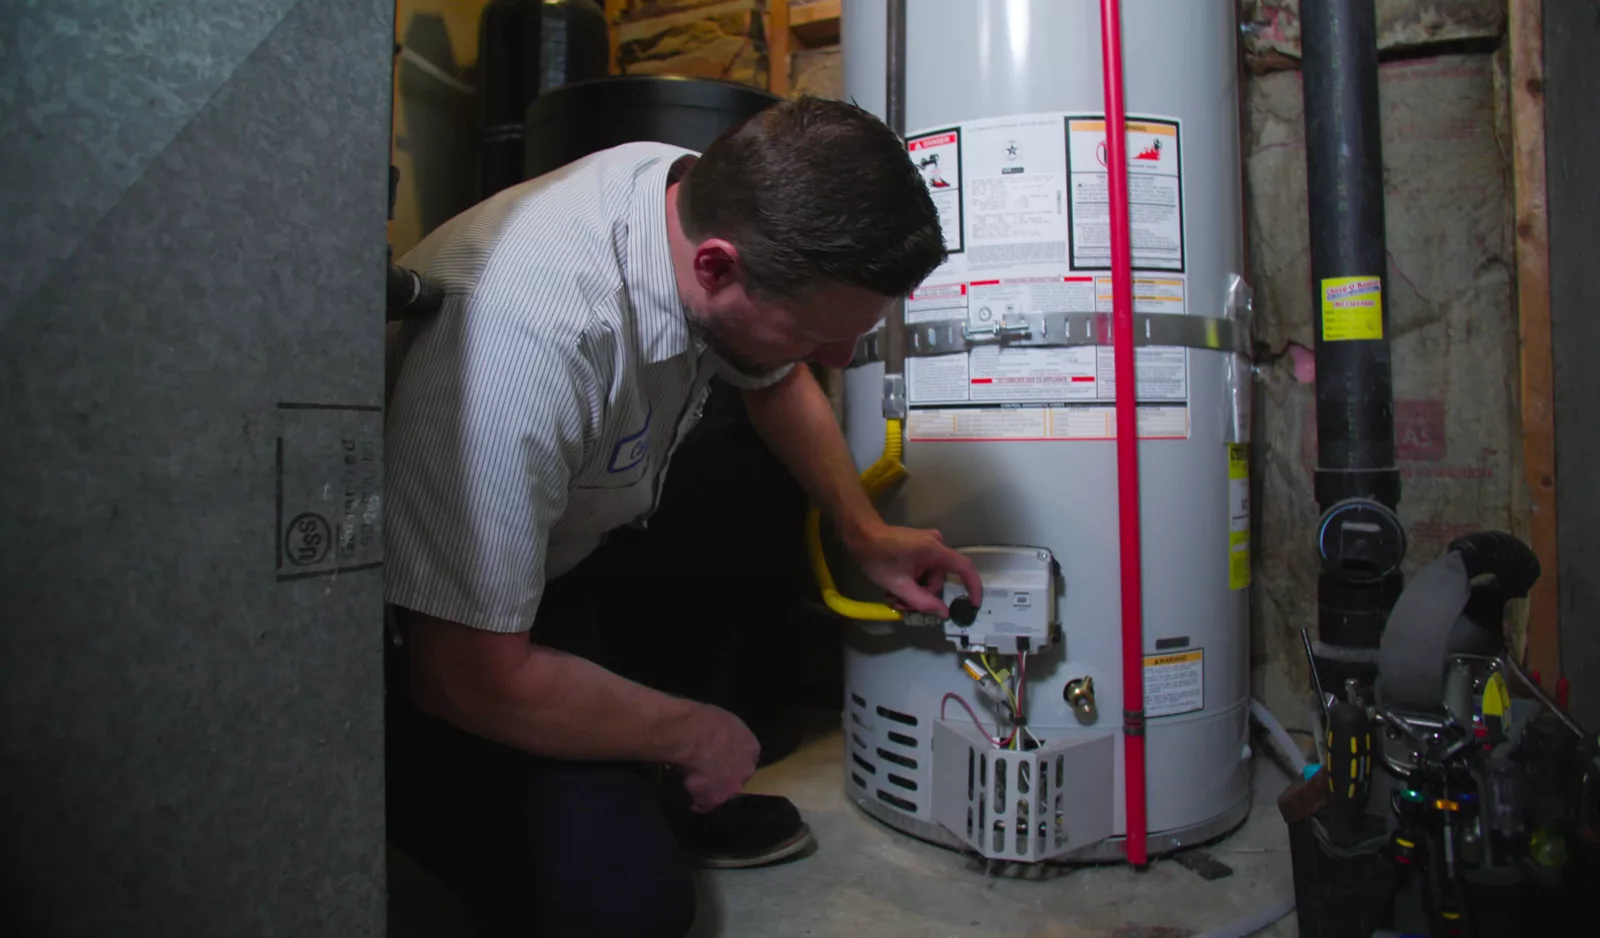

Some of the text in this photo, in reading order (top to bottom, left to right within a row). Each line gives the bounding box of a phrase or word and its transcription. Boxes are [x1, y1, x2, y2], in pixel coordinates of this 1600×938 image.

[923, 135, 951, 148] DANGER
[297, 519, 322, 561] USS
[1160, 653, 1187, 665] WARNING
